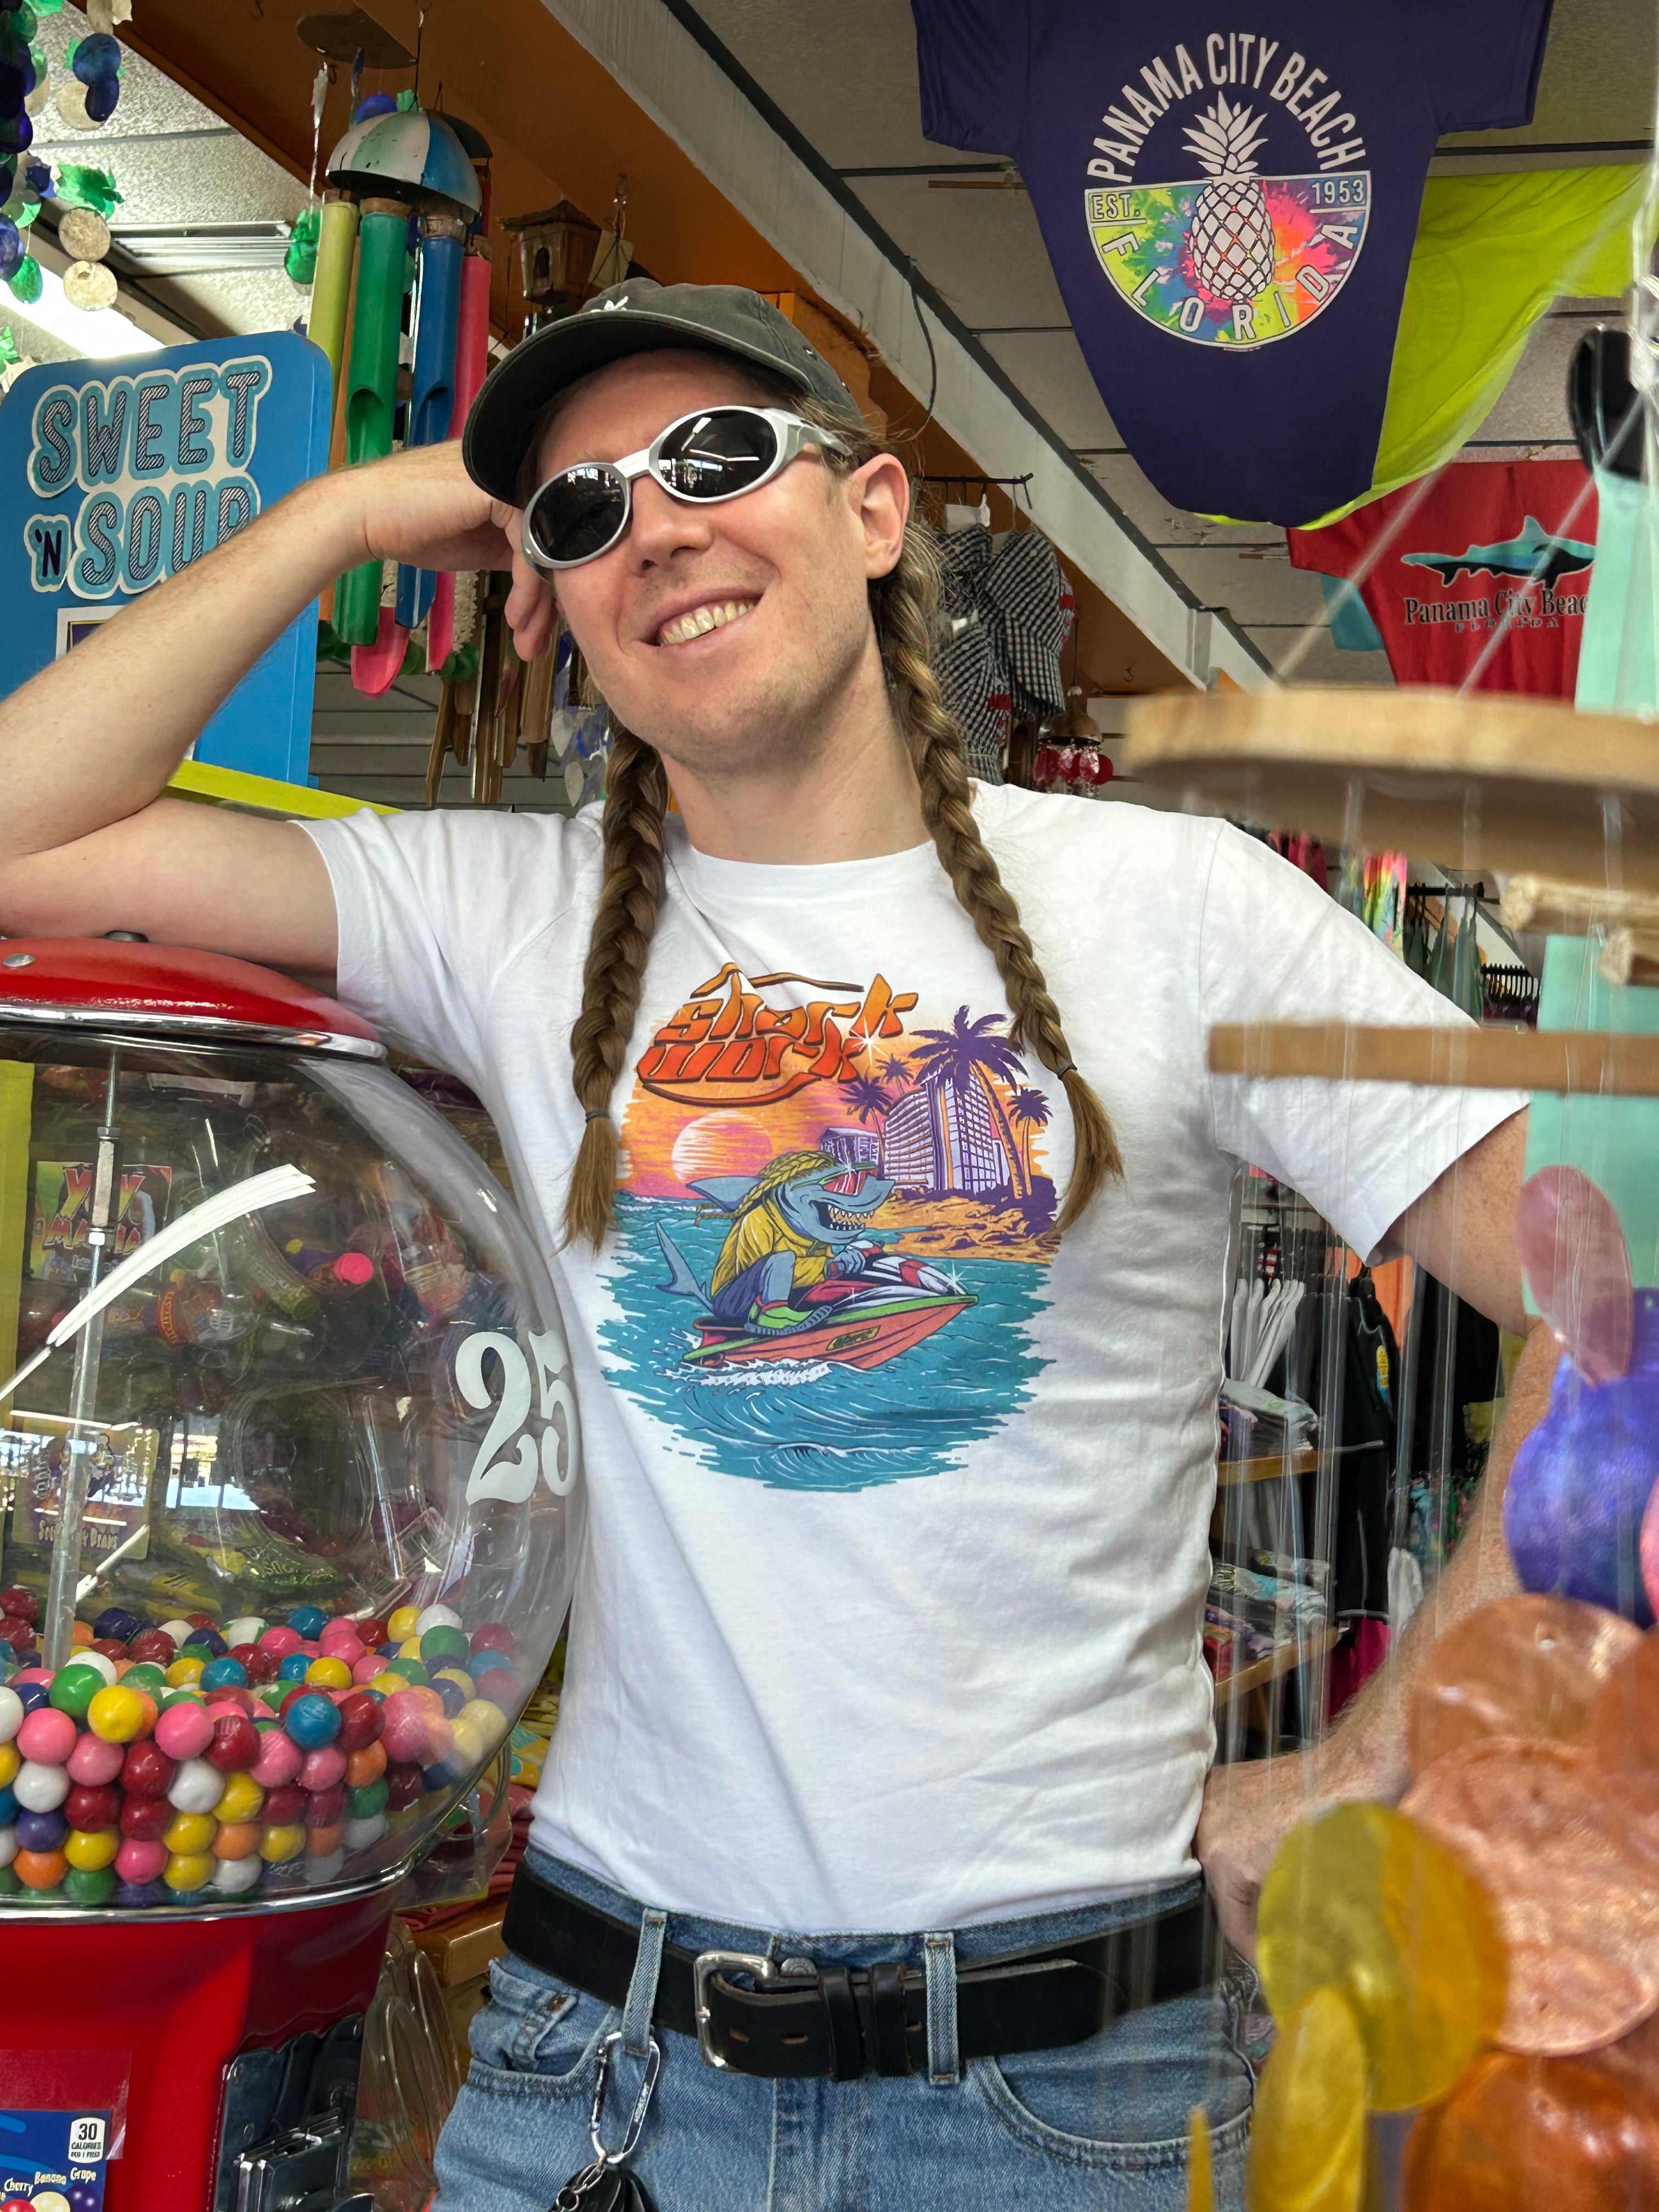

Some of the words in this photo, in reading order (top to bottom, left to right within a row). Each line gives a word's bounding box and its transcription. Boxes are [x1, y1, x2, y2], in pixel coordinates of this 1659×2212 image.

[1087, 44, 1203, 183] PANAMA
[1206, 32, 1279, 89] CITY
[1269, 52, 1366, 171] BEACH
[1091, 194, 1141, 219] EST.
[1311, 179, 1364, 205] 1953
[1102, 225, 1358, 340] FLORIDA
[39, 371, 261, 484] SWEET
[1403, 597, 1489, 625] Panama
[1539, 588, 1589, 616] Beac
[1455, 617, 1560, 633] FLOIDA
[43, 1213, 142, 1255] MAIA
[455, 1330, 579, 1505] 25
[78, 2123, 98, 2140] 30
